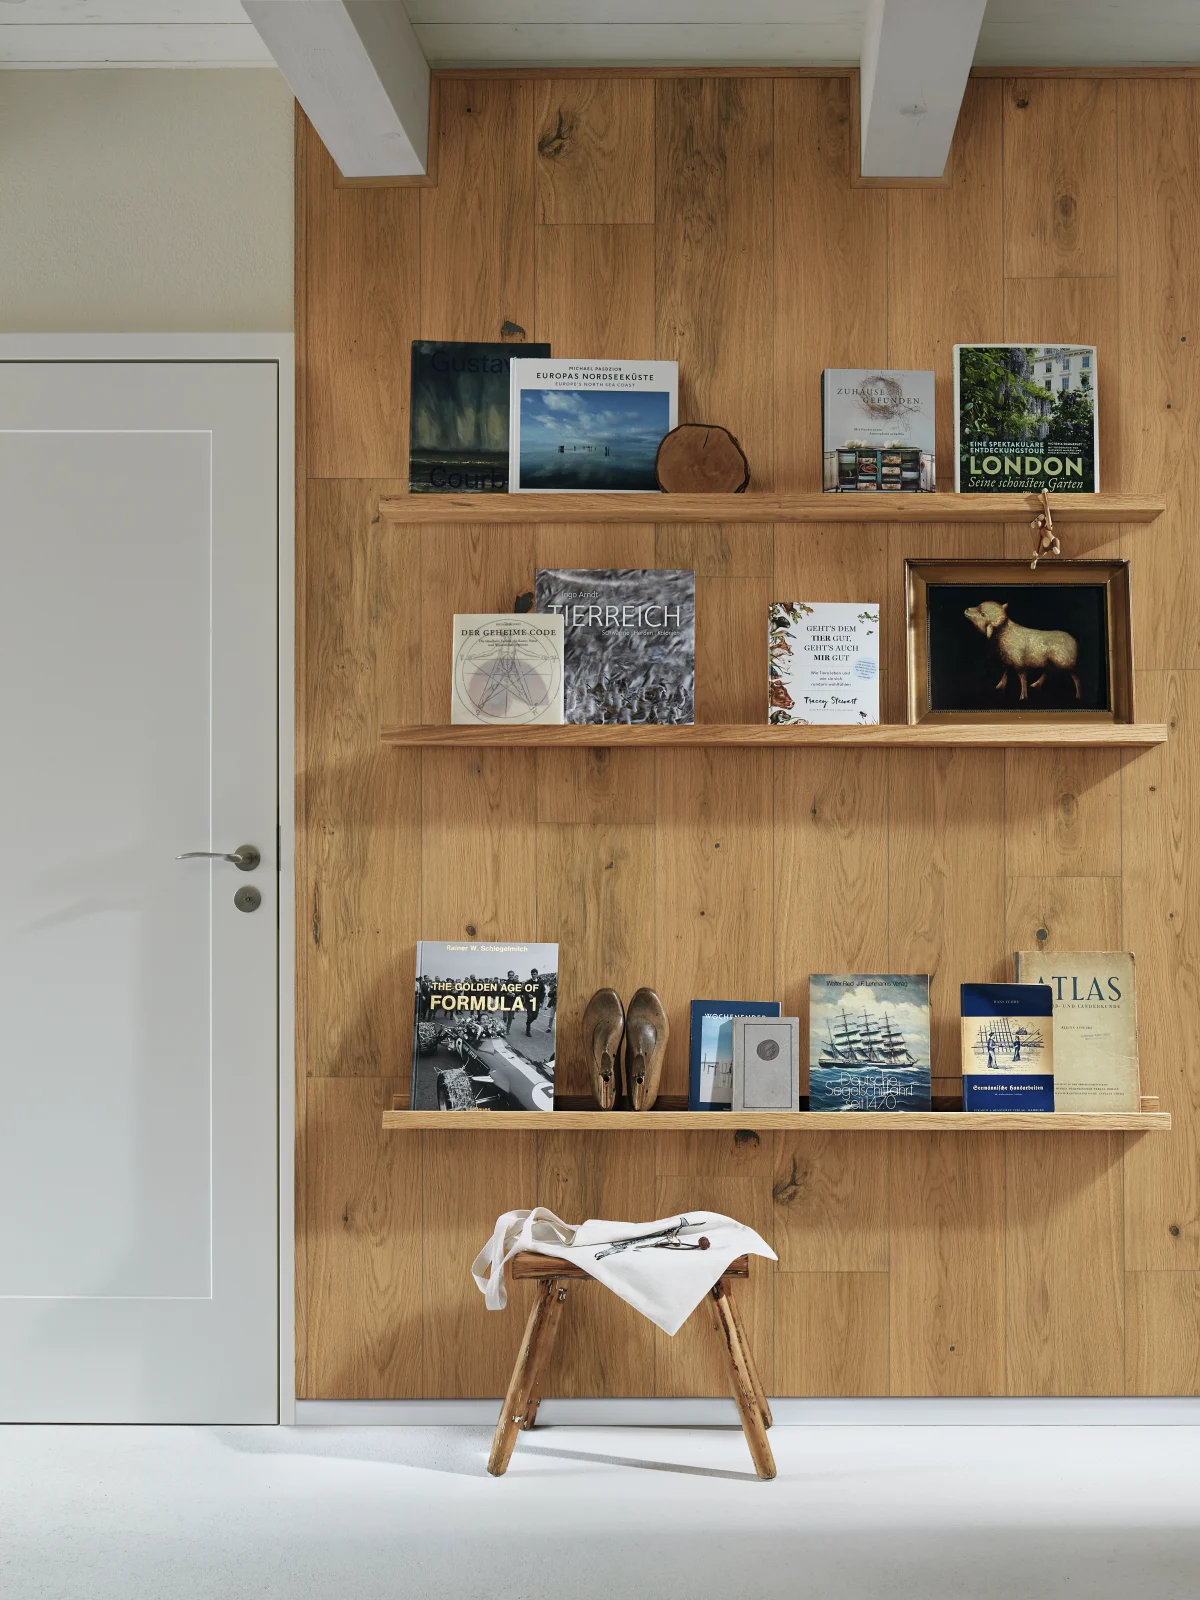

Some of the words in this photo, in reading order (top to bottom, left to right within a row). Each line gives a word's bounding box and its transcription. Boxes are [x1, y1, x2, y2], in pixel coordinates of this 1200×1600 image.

[432, 350, 511, 374] Gustav
[536, 372, 579, 380] EUROPAS
[582, 372, 654, 381] NORDSEEKÜSTE
[863, 397, 923, 405] GEFUNDEN.
[988, 440, 1044, 448] SPEKTAKULÄRE
[970, 455, 1083, 476] LONDON
[430, 465, 508, 489] Courb
[968, 476, 996, 488] Seine
[998, 476, 1045, 488] schönsten
[1048, 477, 1084, 492] Gärten
[561, 591, 577, 600] Ingo
[547, 604, 680, 627] TIERREICH
[529, 629, 557, 637] CODE
[832, 635, 852, 643] GUT,
[803, 696, 828, 709] Tracey
[831, 695, 859, 705] Stewart
[480, 945, 528, 953] Schlegelmilch
[432, 982, 452, 991] THE
[454, 982, 497, 992] GOLDEN
[500, 983, 522, 992] AGE
[524, 983, 540, 993] OF
[892, 980, 908, 988] Verlag
[430, 995, 525, 1012] FORMULA
[529, 996, 537, 1012] 1
[840, 1070, 897, 1087] Deutsche
[846, 1096, 864, 1110] seit
